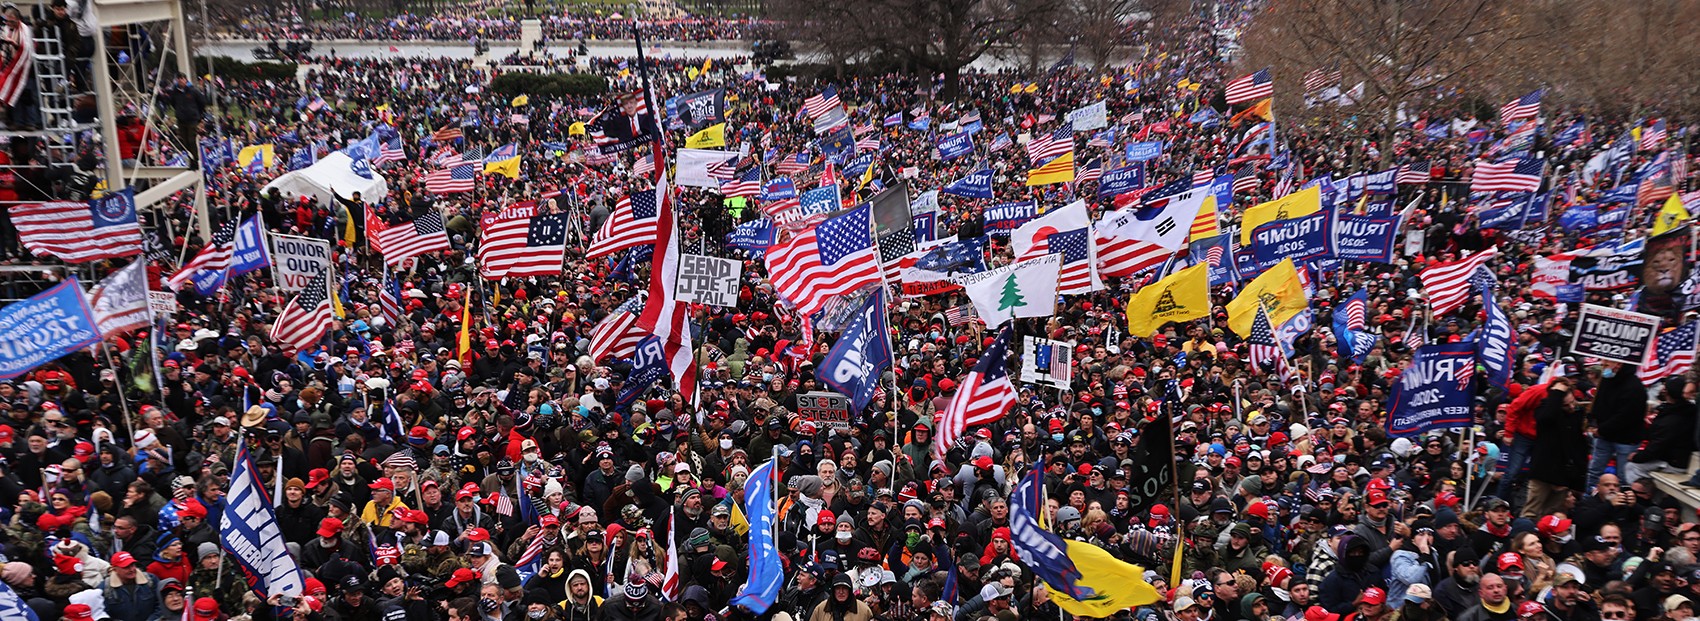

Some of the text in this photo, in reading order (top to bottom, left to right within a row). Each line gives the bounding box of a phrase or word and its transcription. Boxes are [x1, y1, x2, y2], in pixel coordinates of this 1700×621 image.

[276, 241, 326, 259] HONOR
[287, 258, 321, 272] OUR
[684, 255, 731, 278] SEND
[284, 274, 314, 288] VOT
[679, 275, 738, 295] JOE TO
[150, 292, 173, 300] STOP
[692, 290, 728, 305] JAIL
[150, 303, 175, 313] STEAL
[1585, 318, 1649, 341] TRUMP
[1589, 341, 1631, 357] 2020
[801, 409, 847, 421] STEAL
